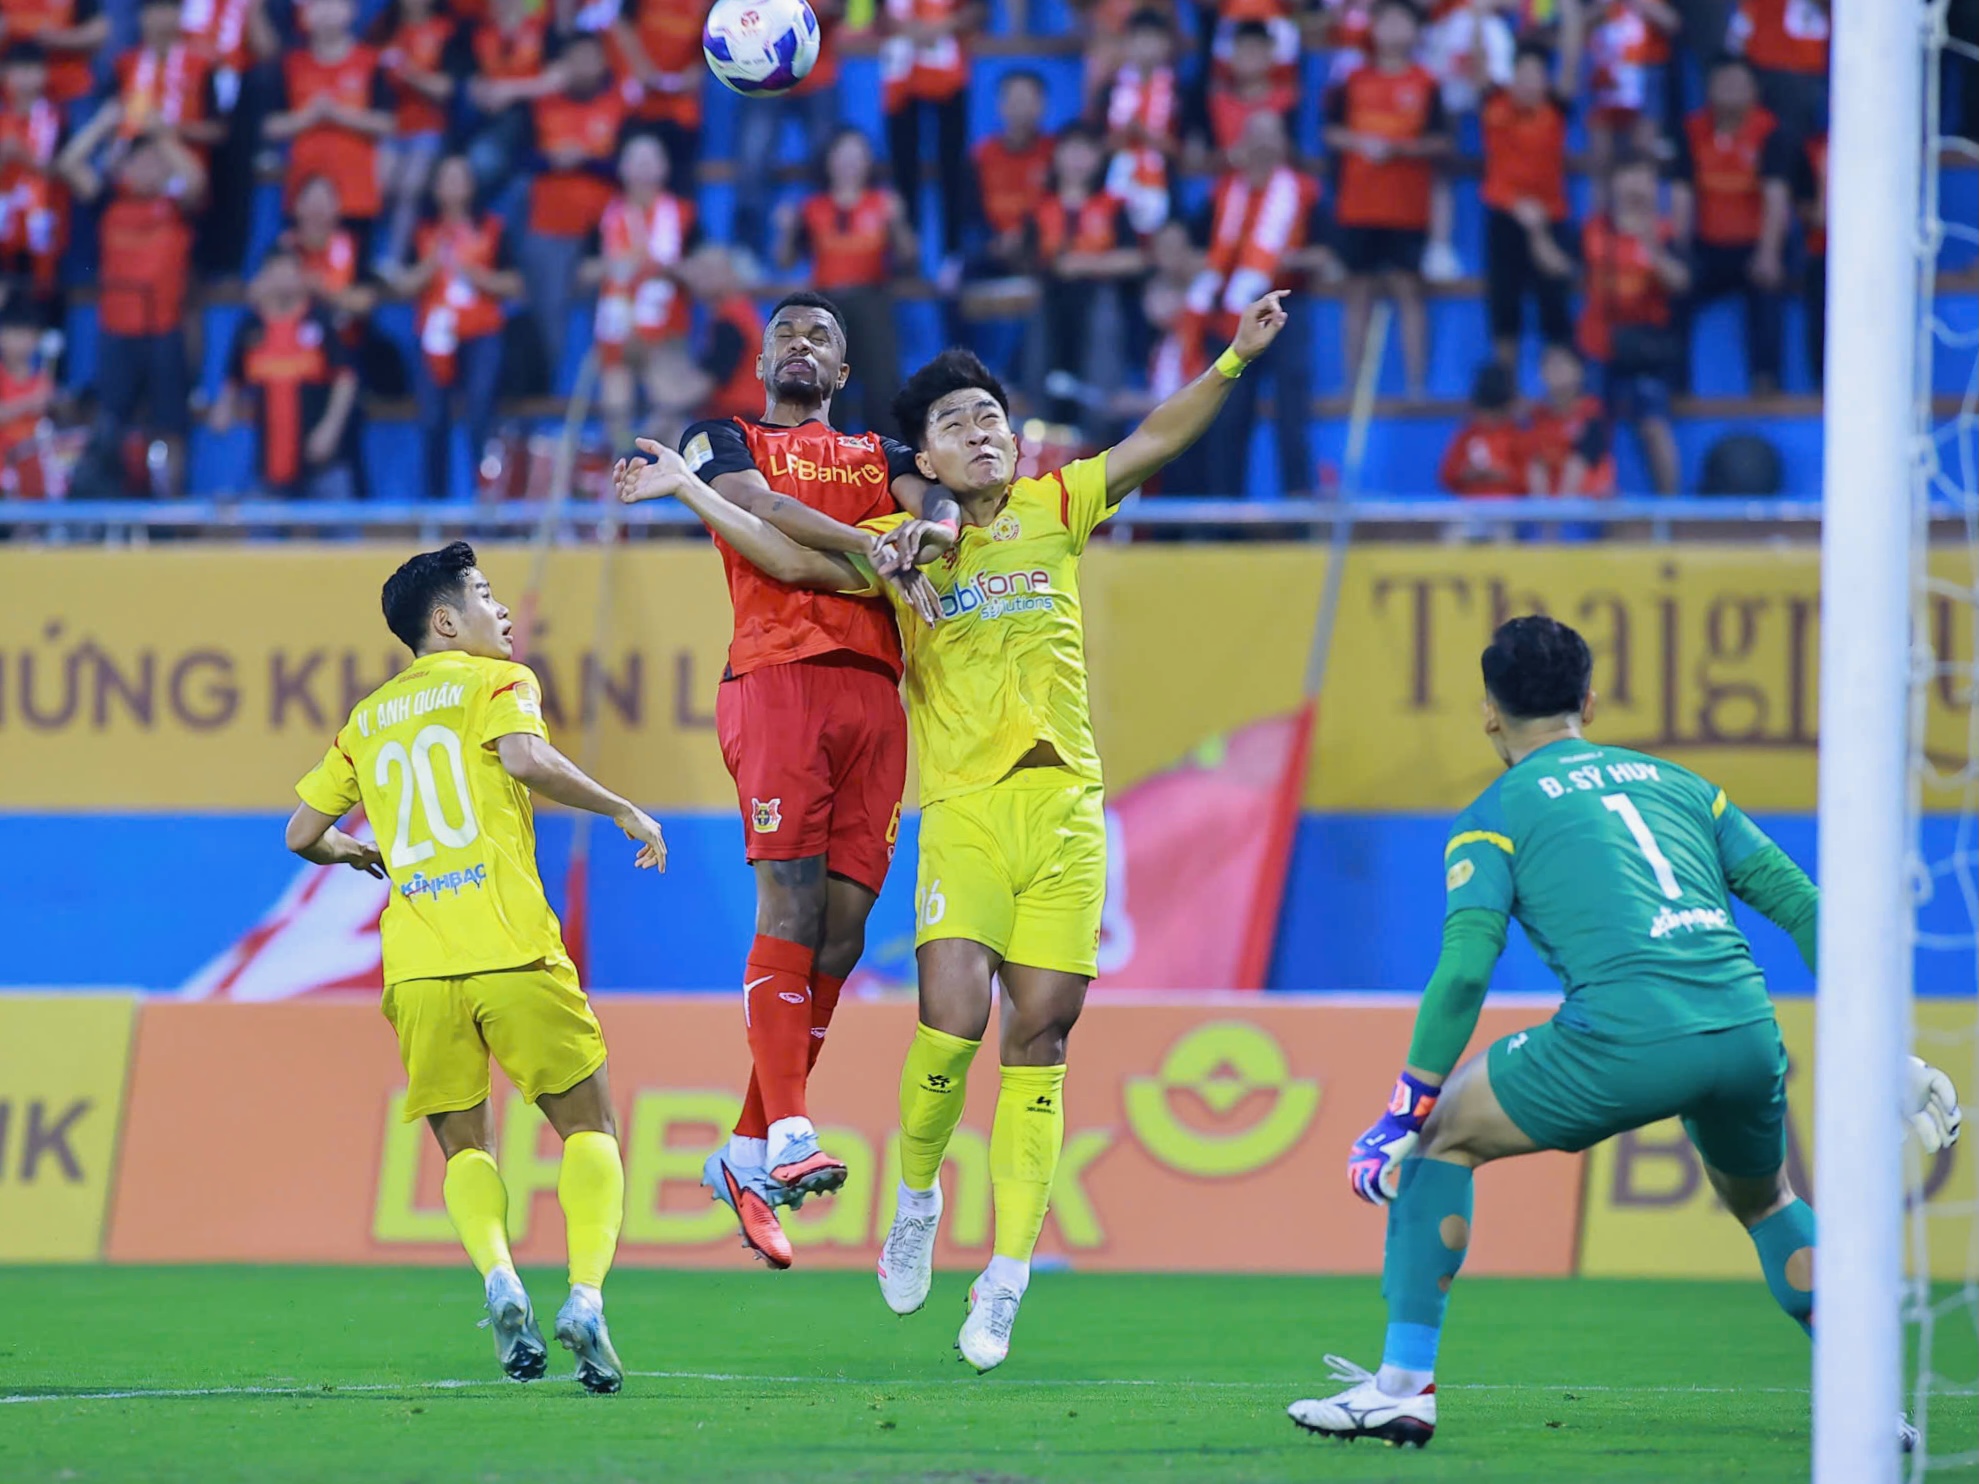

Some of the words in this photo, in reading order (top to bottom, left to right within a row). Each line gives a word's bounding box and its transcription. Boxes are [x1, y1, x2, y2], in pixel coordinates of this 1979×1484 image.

[939, 571, 1050, 617] obifone
[0, 617, 242, 731] ỨNG
[377, 694, 411, 730] ANH
[375, 724, 480, 869] 20
[1605, 762, 1660, 784] HUY
[1600, 793, 1683, 900] 1
[917, 879, 947, 932] 16
[0, 1099, 94, 1182] K
